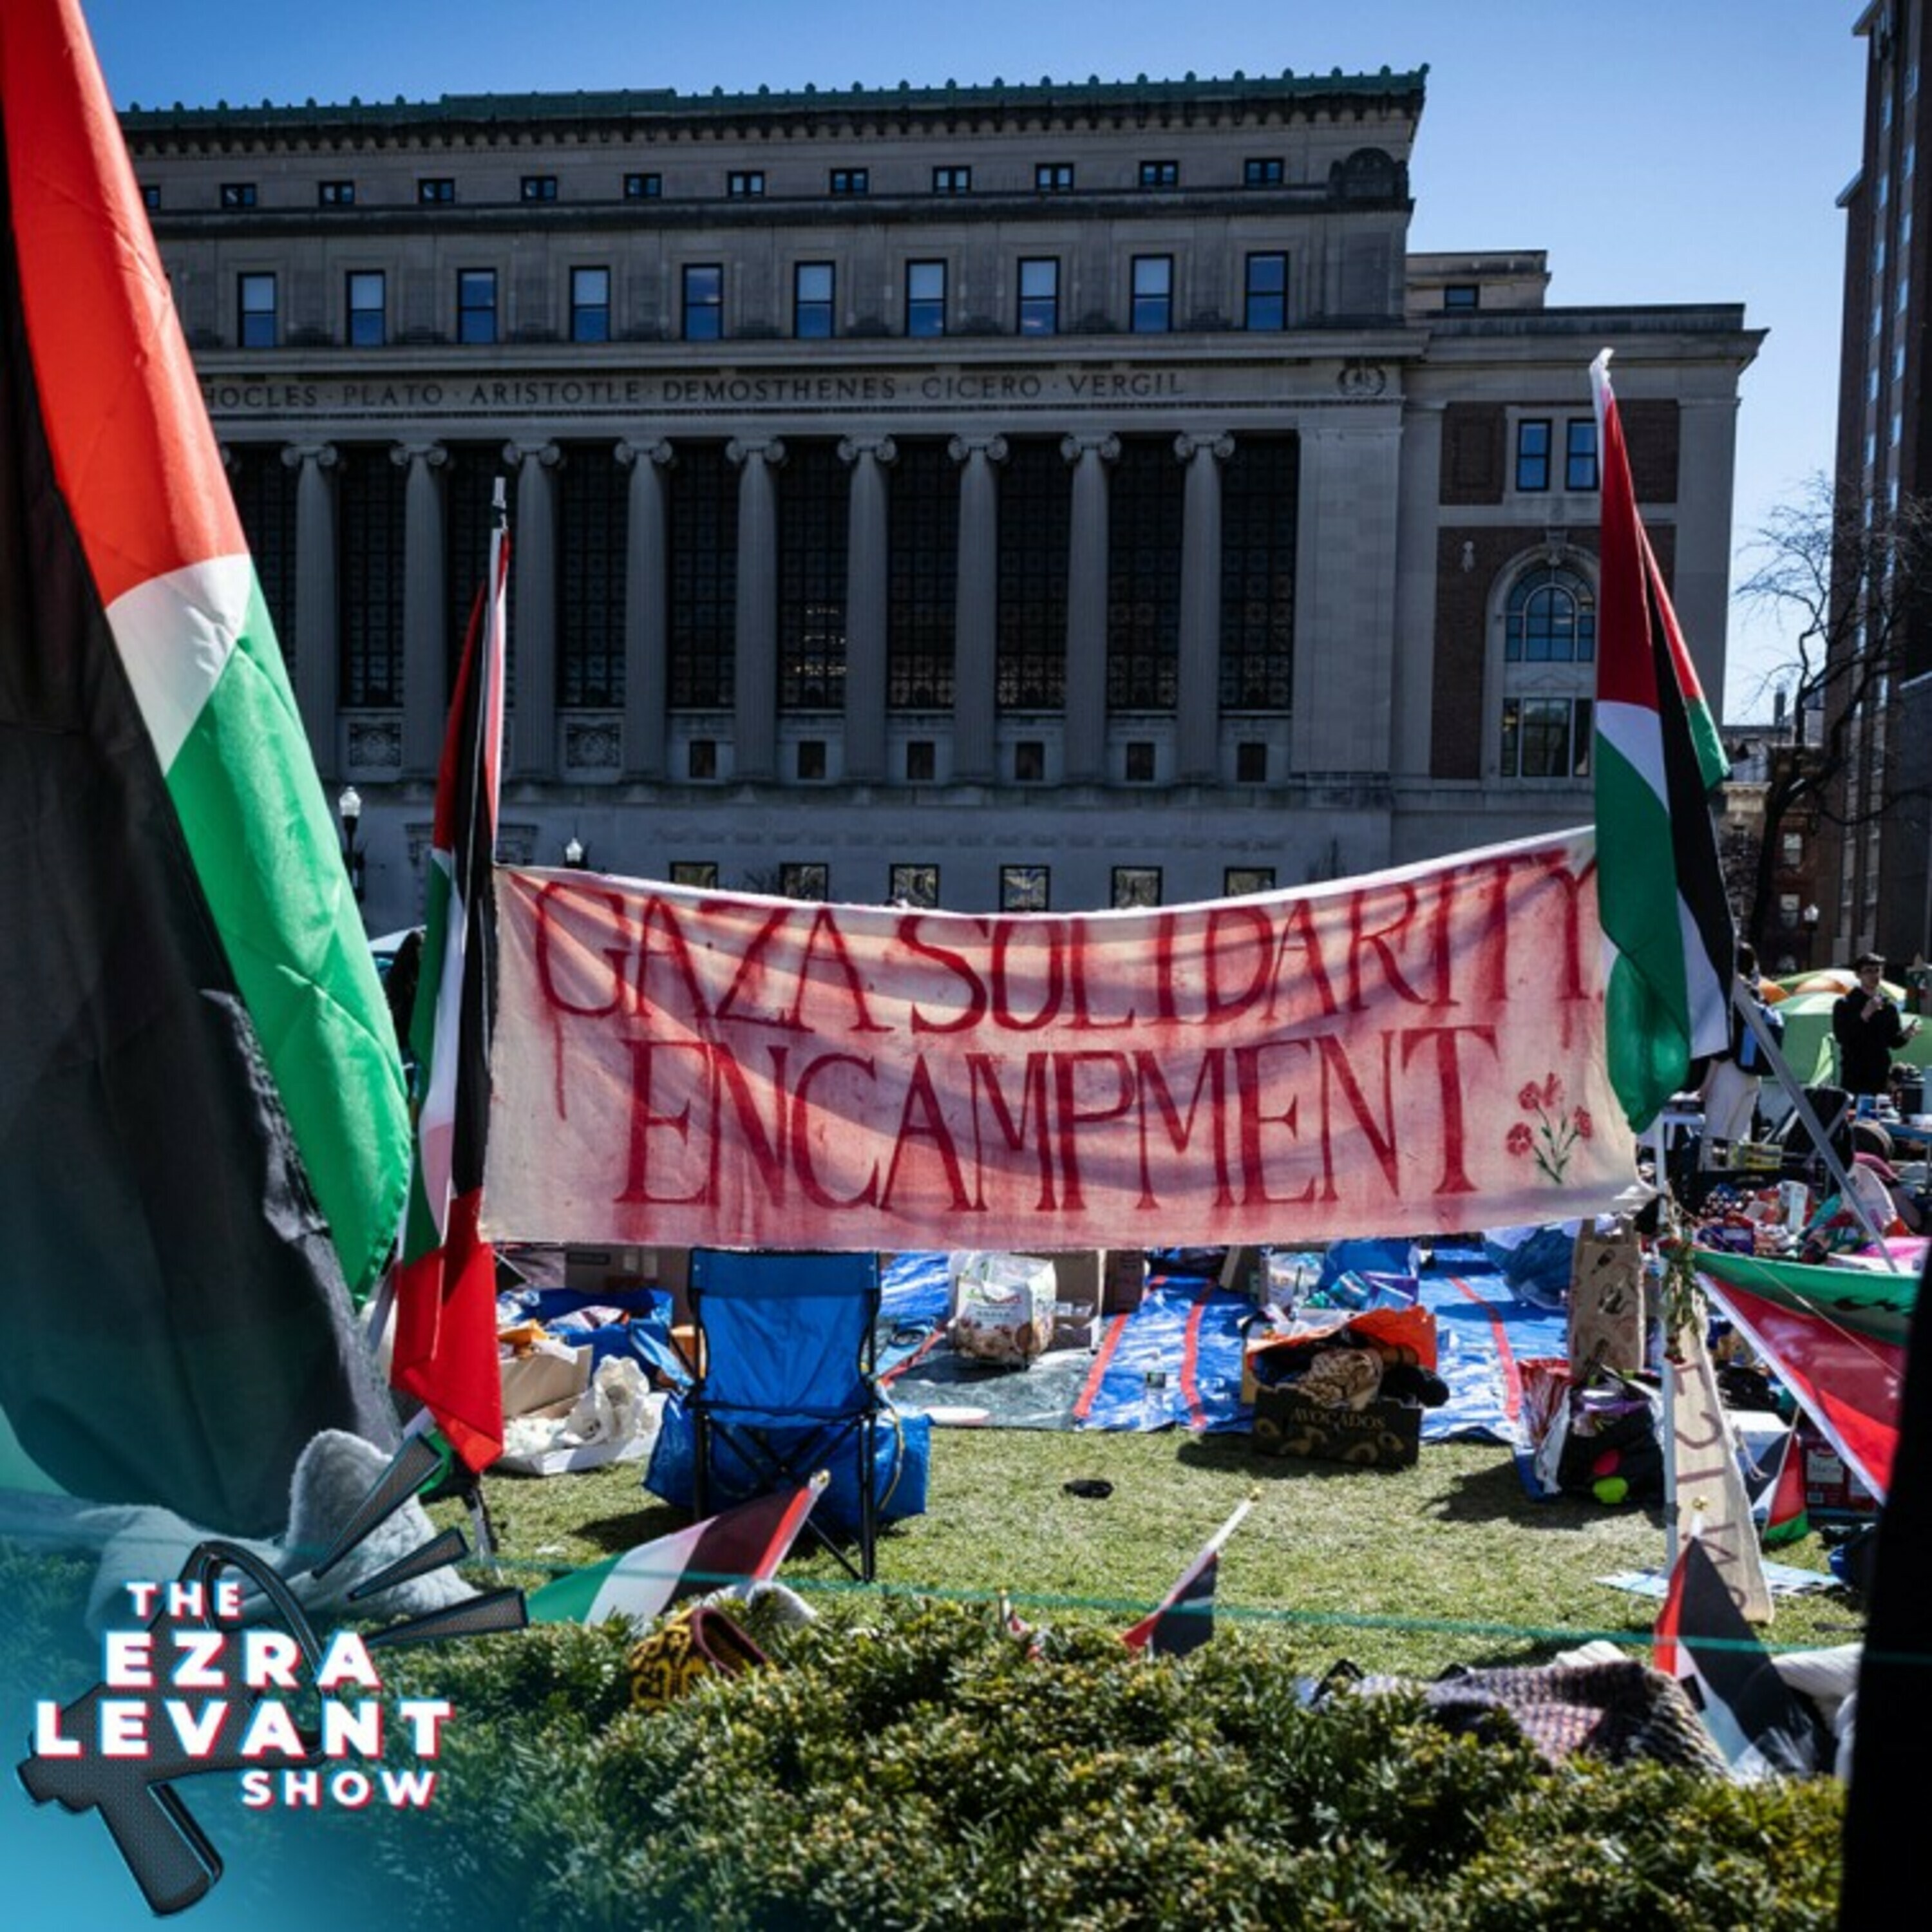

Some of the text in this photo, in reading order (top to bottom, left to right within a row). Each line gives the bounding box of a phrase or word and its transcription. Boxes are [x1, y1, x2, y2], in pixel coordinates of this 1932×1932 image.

[343, 383, 444, 406] PLATO
[469, 381, 641, 405] ARISTOTLE
[663, 377, 897, 402] DEMOSTHENES
[922, 374, 1043, 399] CICERO
[1067, 372, 1185, 397] VERGIL
[534, 847, 1597, 1032] GAZA SOLIDARITY
[615, 1024, 1499, 1212] ENCAMPMENT
